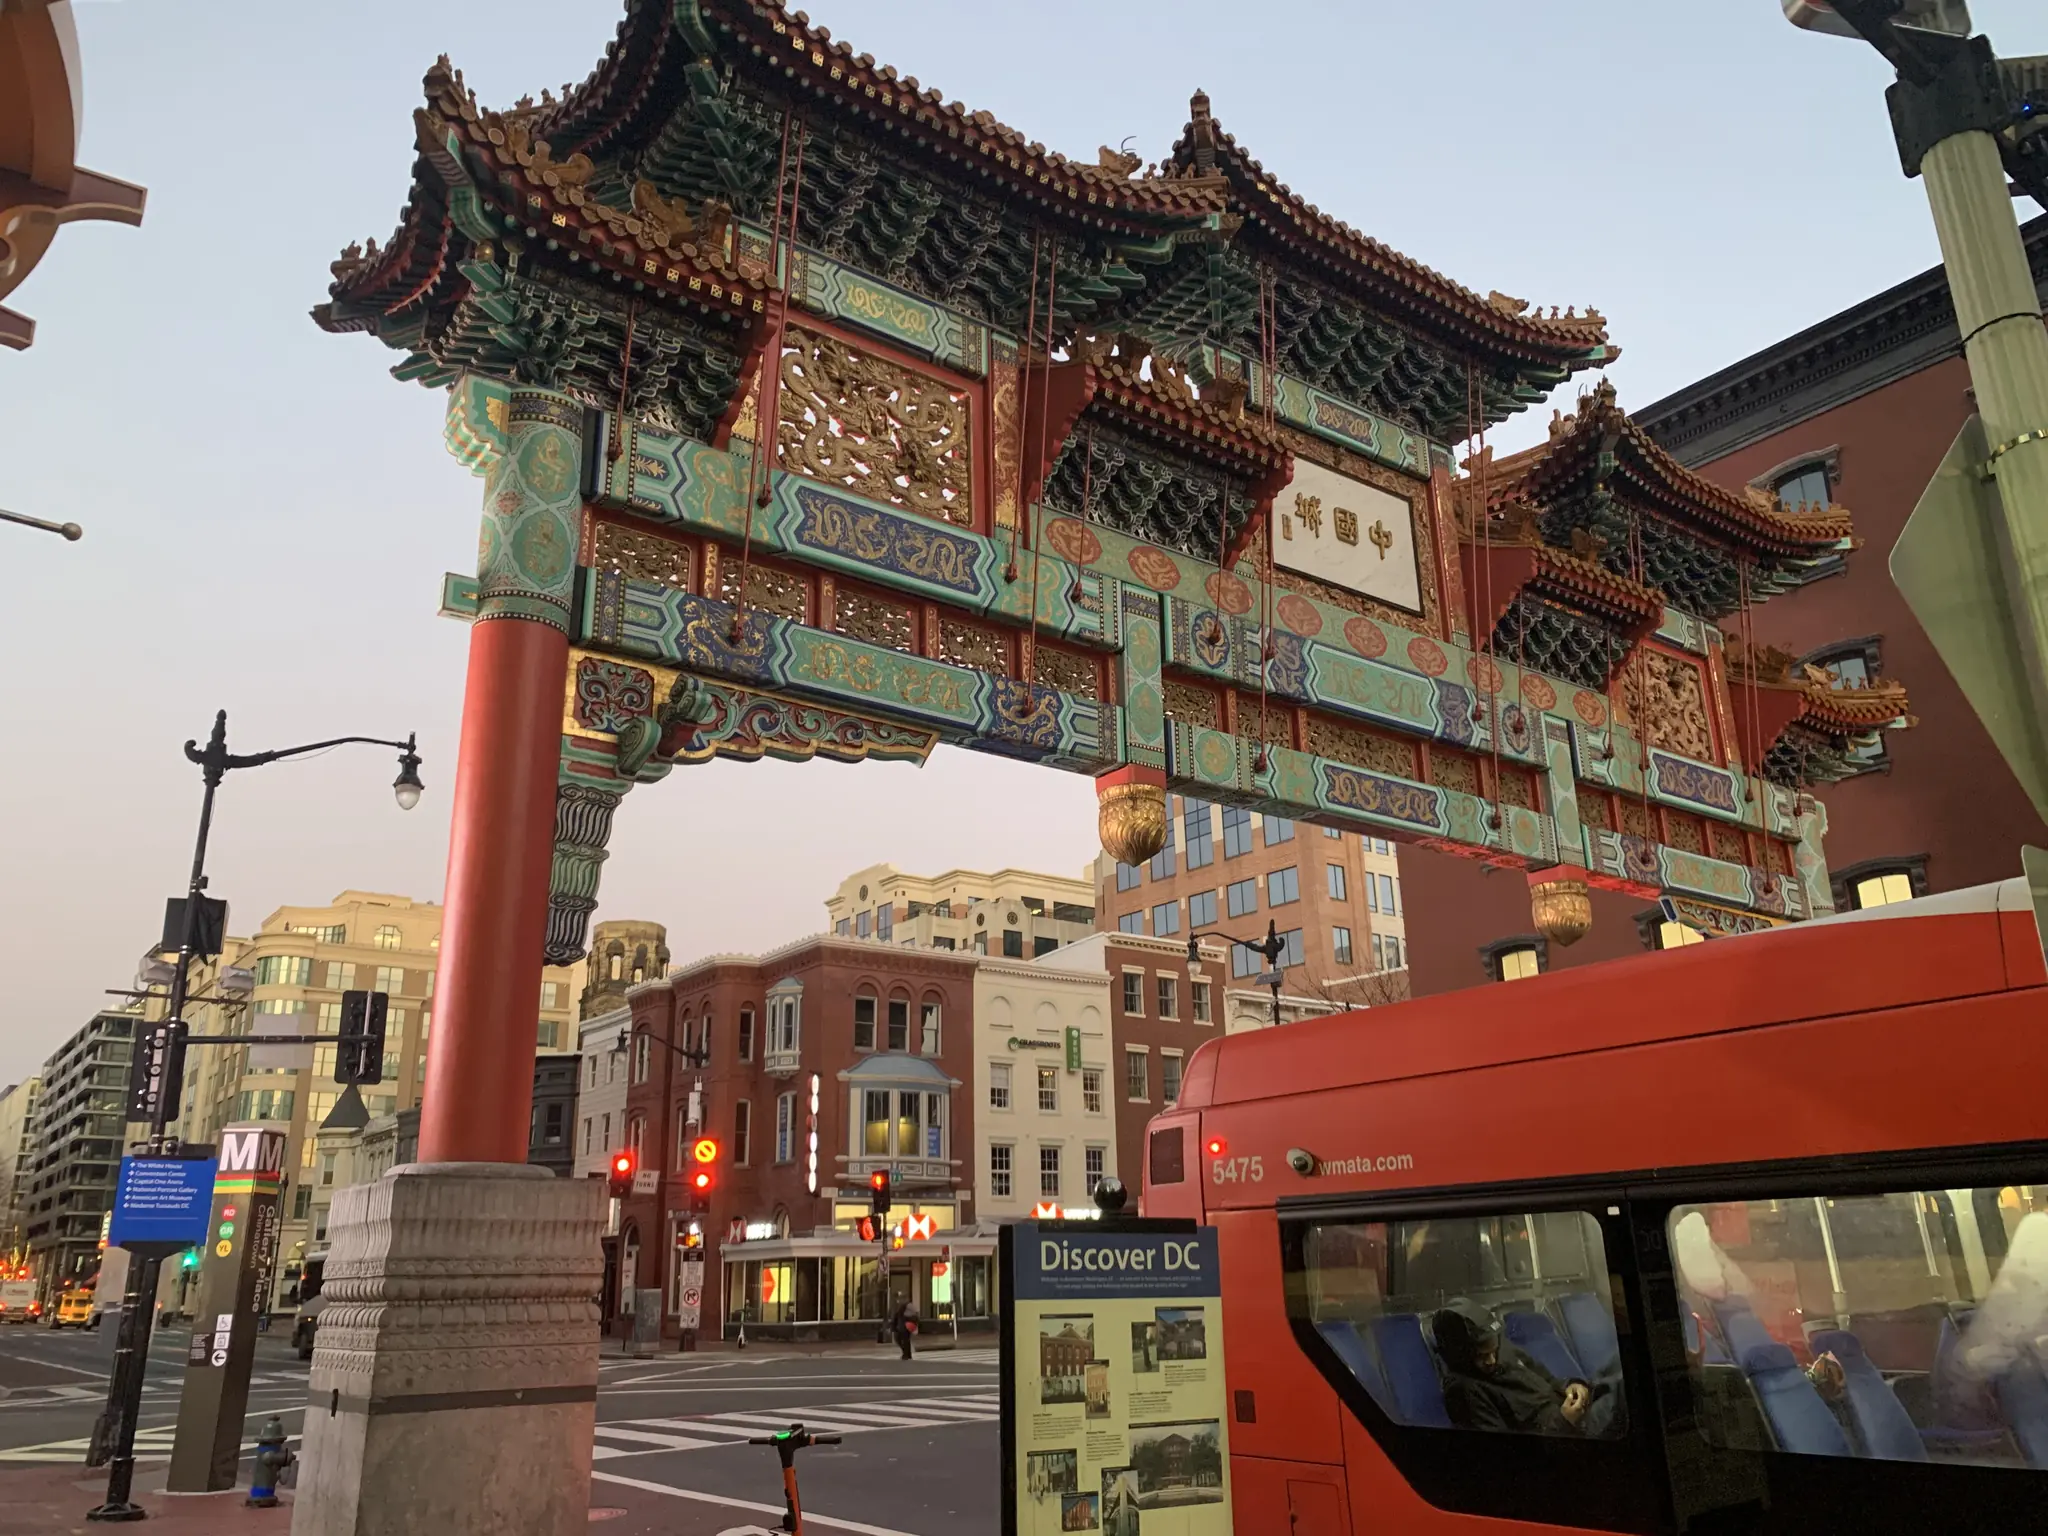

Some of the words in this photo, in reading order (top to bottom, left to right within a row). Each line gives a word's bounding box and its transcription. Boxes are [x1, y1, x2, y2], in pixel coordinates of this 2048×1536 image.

[219, 1133, 260, 1172] M
[258, 1134, 284, 1172] M
[1319, 1153, 1413, 1176] wmata.com
[635, 1180, 655, 1188] TURNS
[1212, 1156, 1264, 1185] 5475
[223, 1208, 236, 1217] RD
[220, 1226, 234, 1235] GR
[250, 1204, 266, 1269] Chinatown
[260, 1205, 275, 1266] Gallery
[219, 1244, 229, 1252] YL
[1040, 1239, 1156, 1271] Discover
[1163, 1241, 1200, 1271] DC
[252, 1267, 266, 1313] Place
